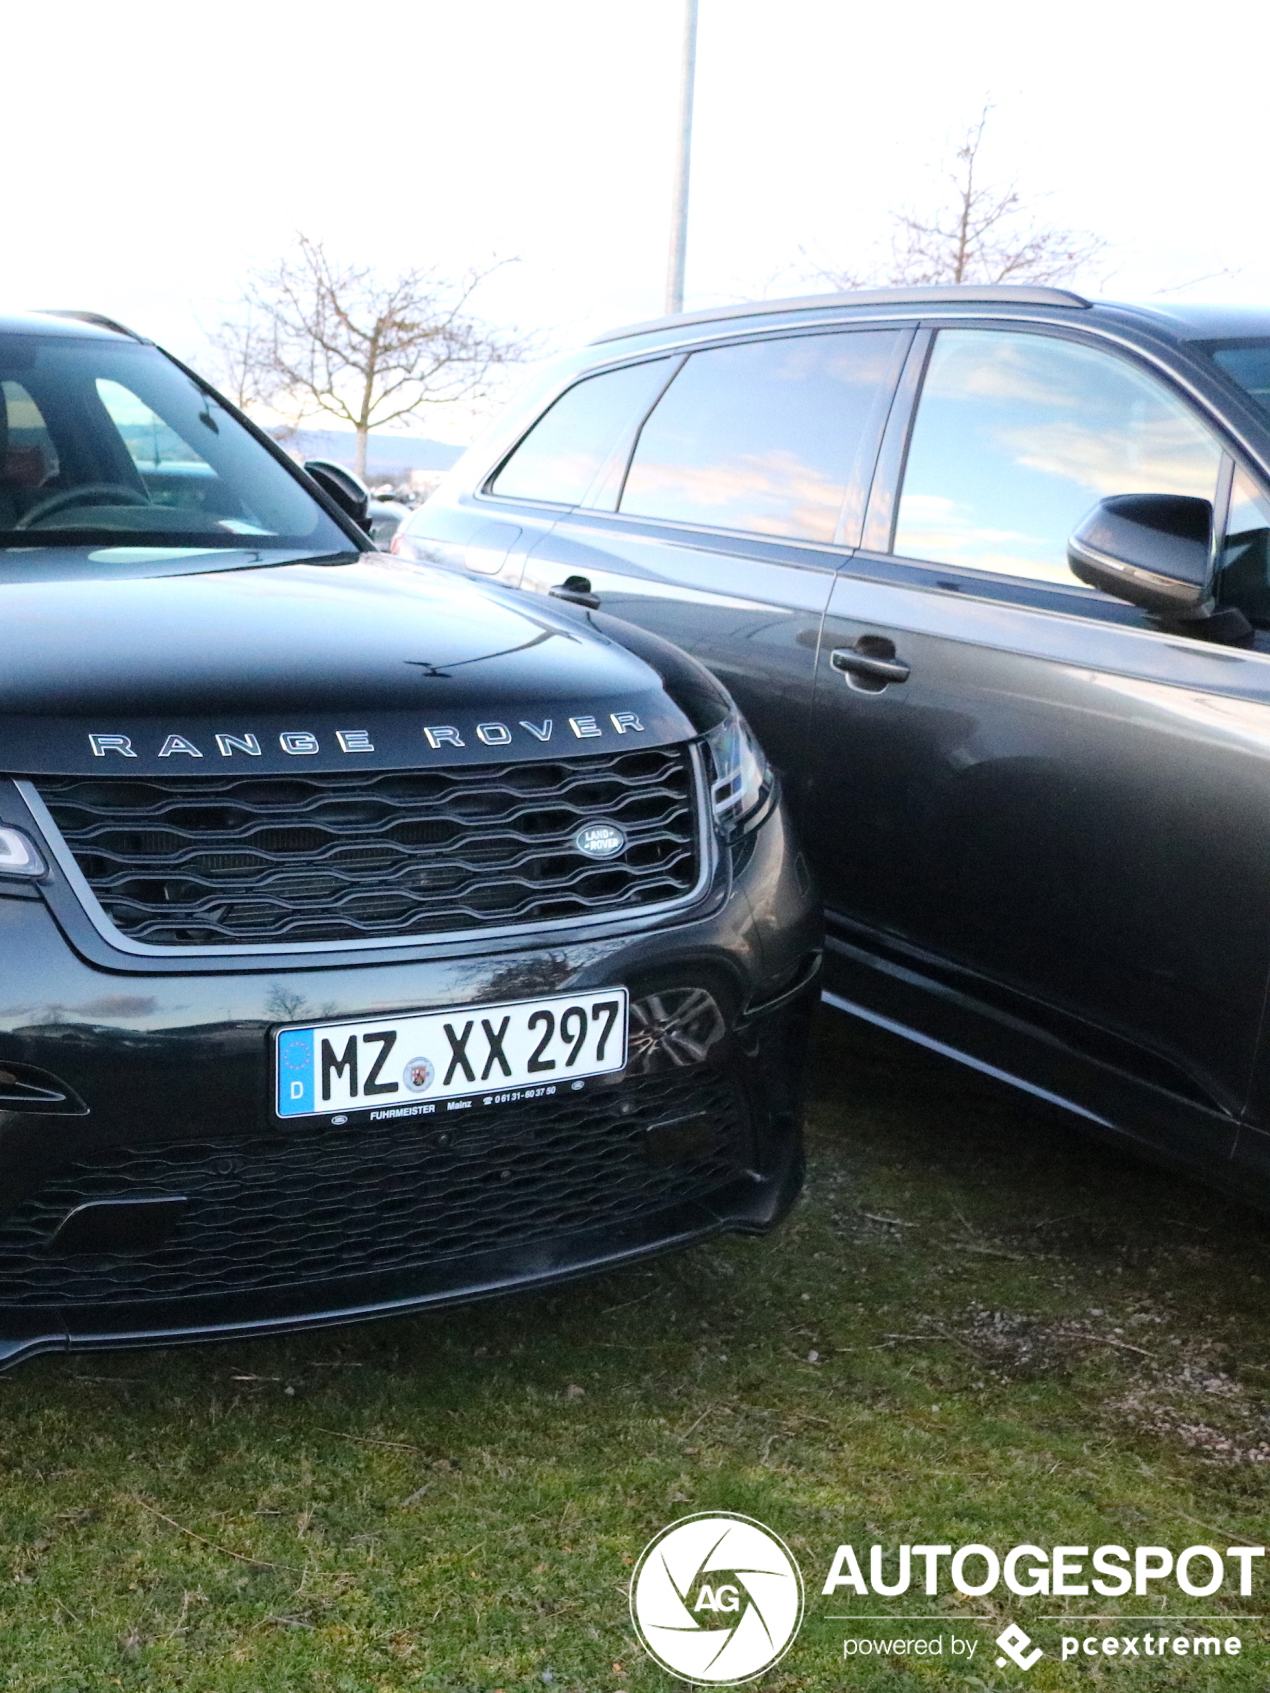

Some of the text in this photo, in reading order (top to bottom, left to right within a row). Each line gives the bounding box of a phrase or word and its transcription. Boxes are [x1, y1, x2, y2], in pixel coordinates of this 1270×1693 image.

[89, 711, 645, 758] RANGE ROVER
[321, 1001, 619, 1101] MZ XX 297
[290, 1081, 304, 1099] D
[370, 1104, 436, 1120] FUHRMEISTER
[447, 1101, 472, 1111] Mainz
